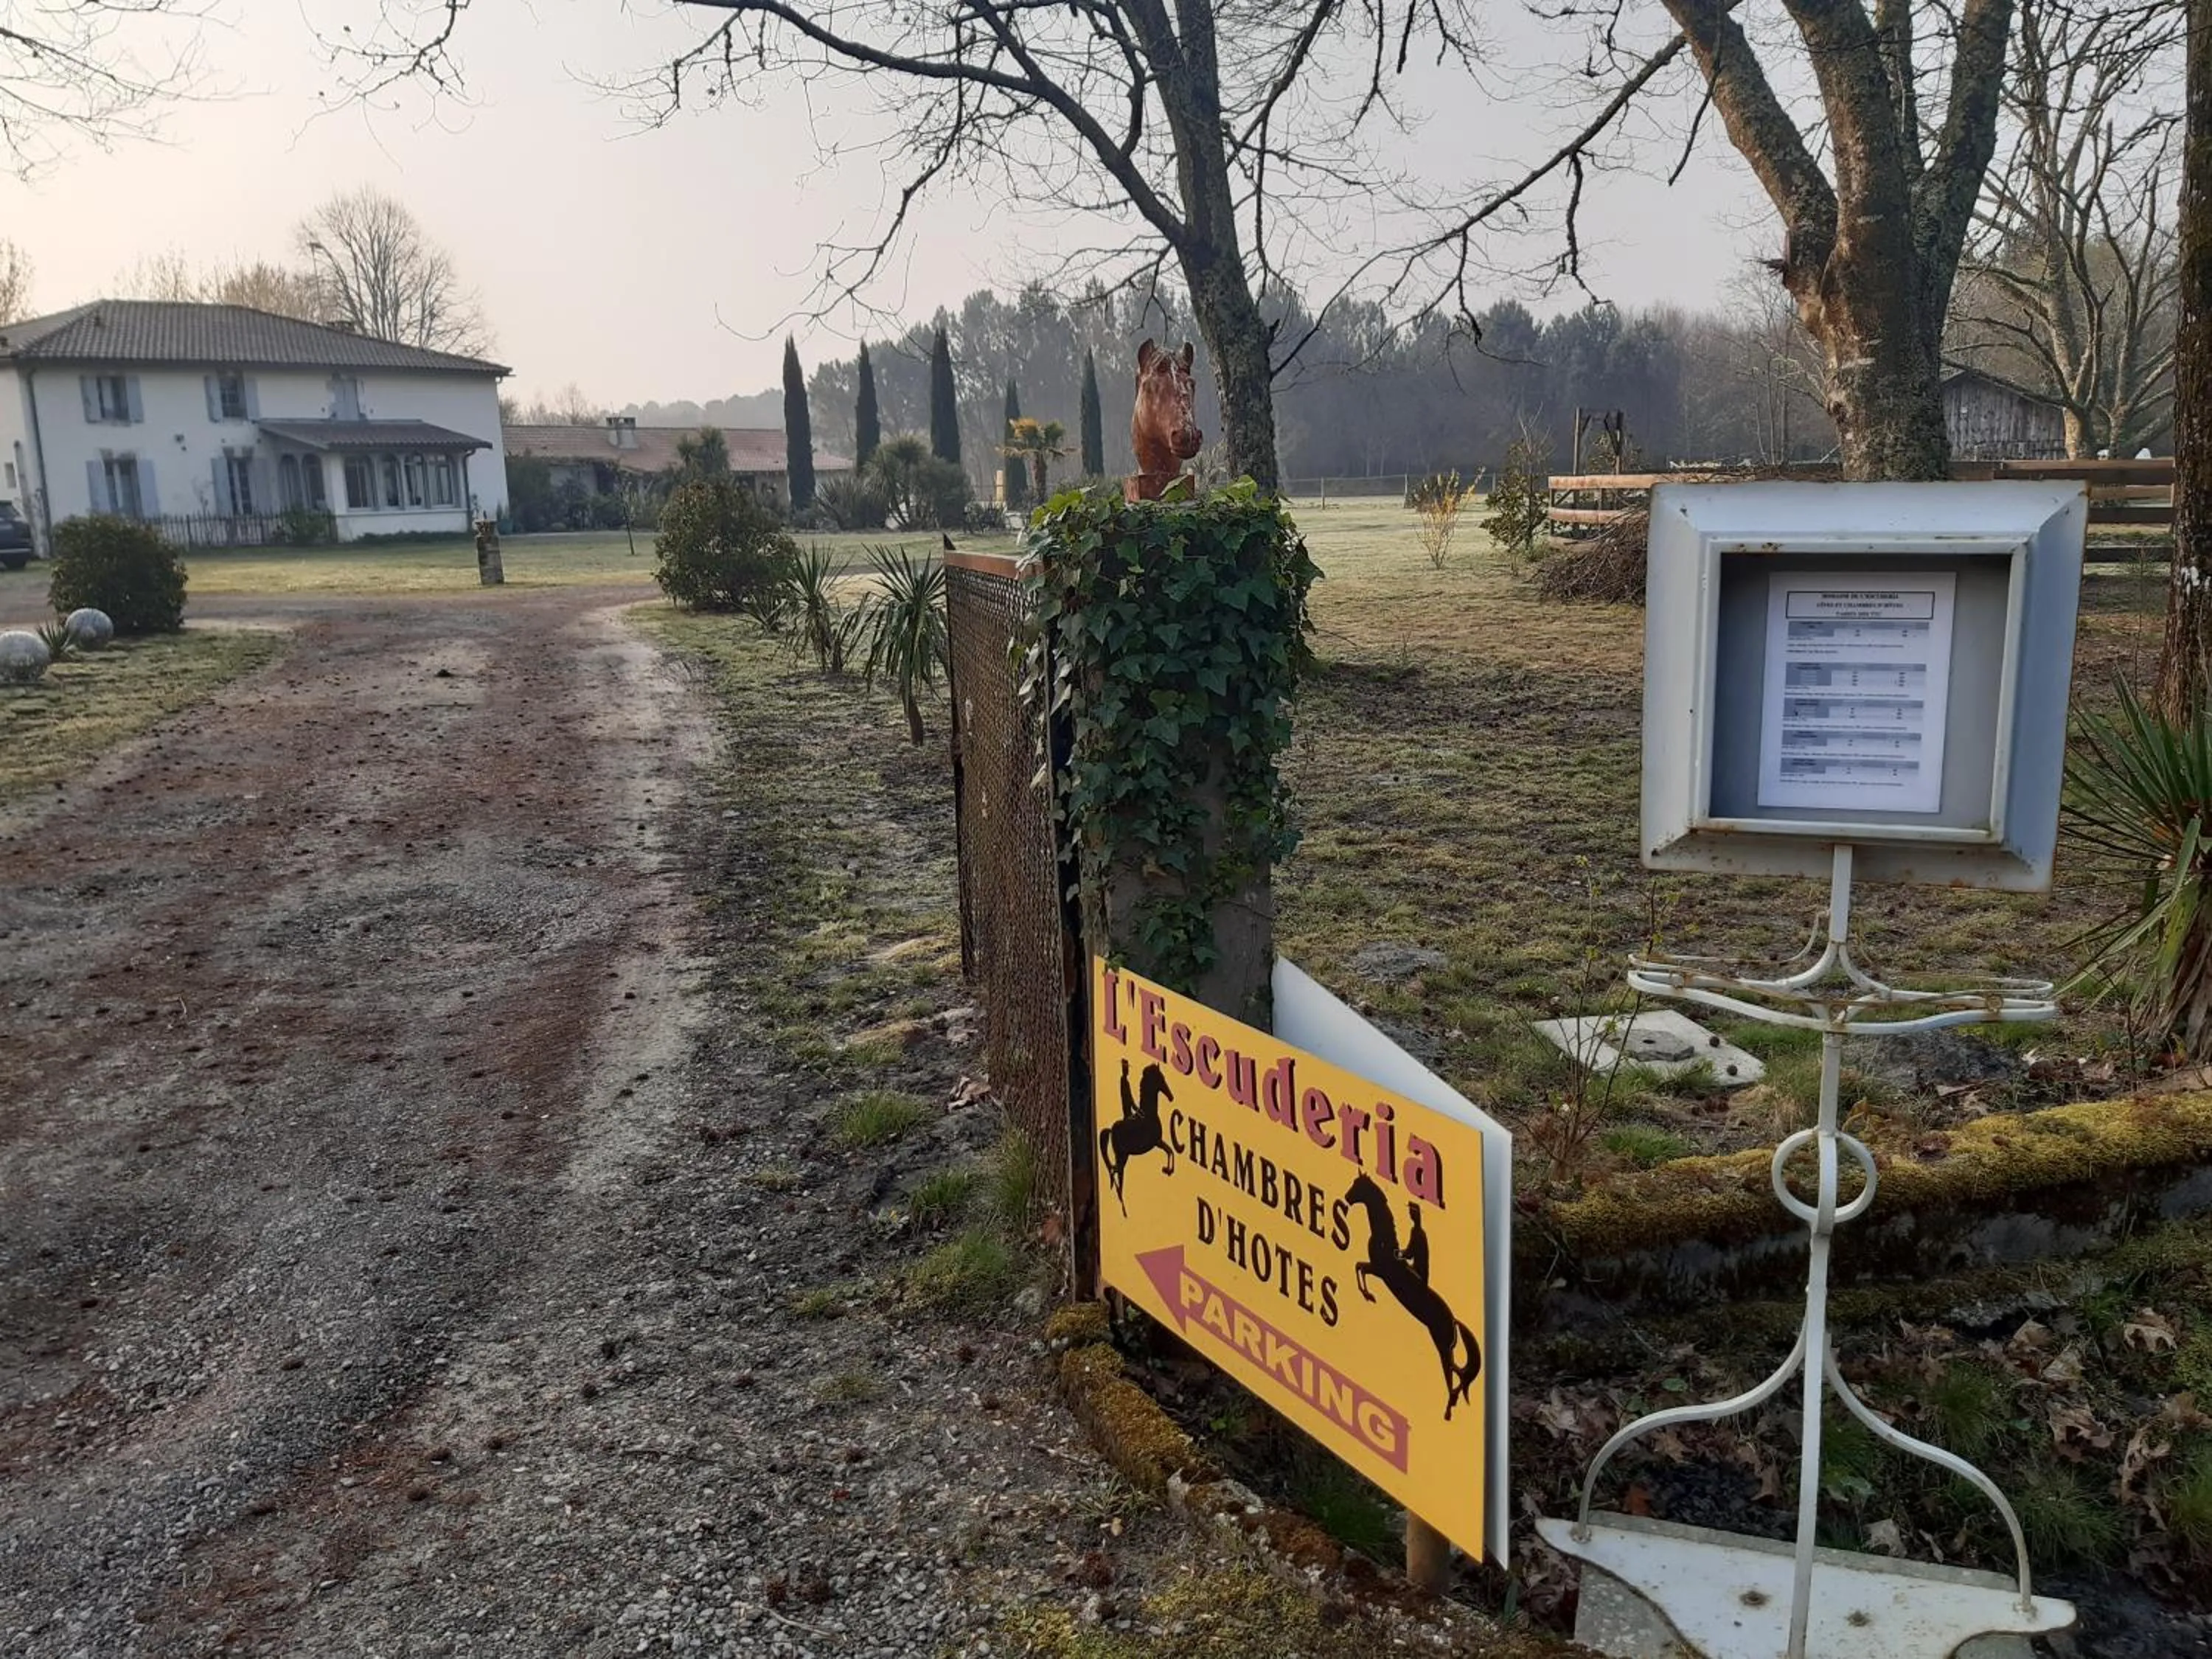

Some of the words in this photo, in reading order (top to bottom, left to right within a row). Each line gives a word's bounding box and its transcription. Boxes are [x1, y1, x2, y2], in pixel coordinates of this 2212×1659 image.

[1103, 969, 1446, 1209] L'Escuderia
[1169, 1108, 1350, 1251] CHAMBRES
[1197, 1196, 1339, 1327] D'HOTES
[1180, 1276, 1396, 1453] PARKING
